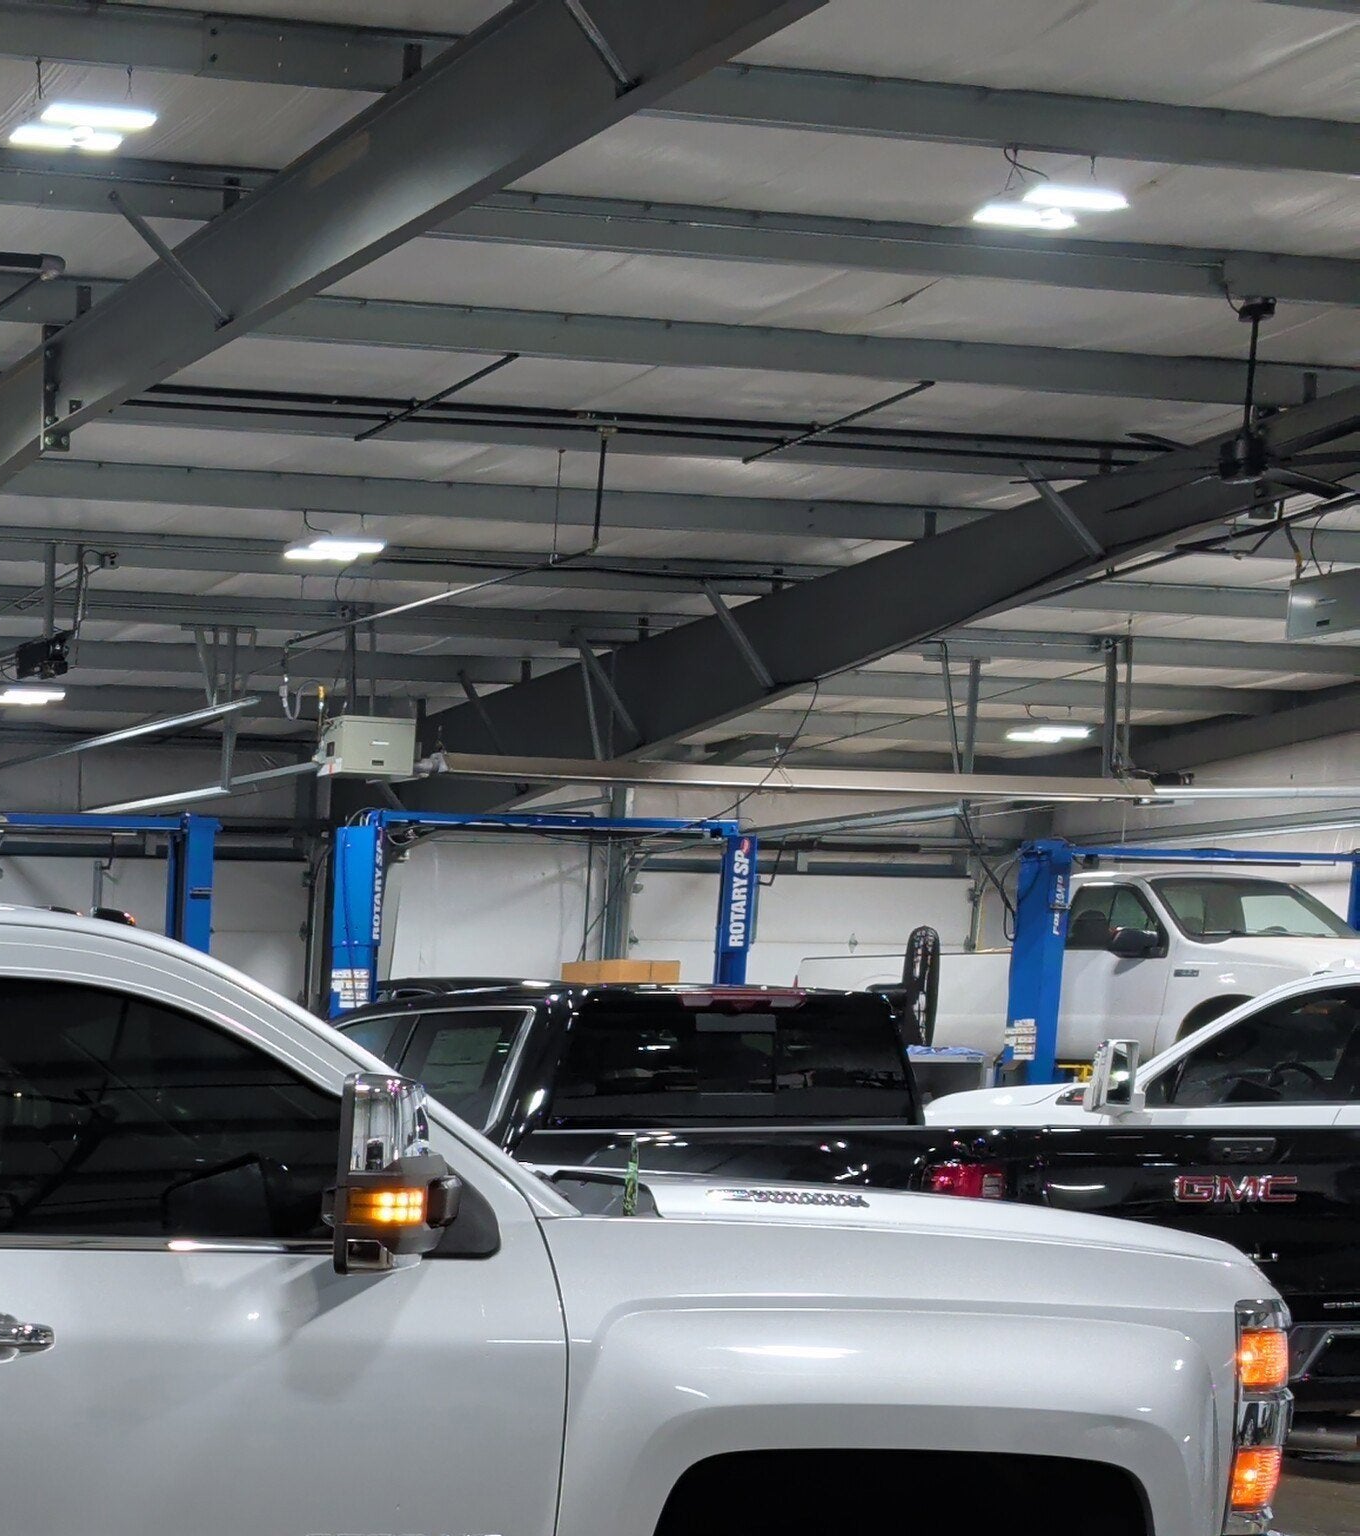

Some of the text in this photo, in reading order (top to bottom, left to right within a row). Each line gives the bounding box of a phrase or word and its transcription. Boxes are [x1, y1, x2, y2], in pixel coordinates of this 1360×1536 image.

[729, 849, 749, 947] ROTARY SP
[1174, 1175, 1298, 1203] GMC
